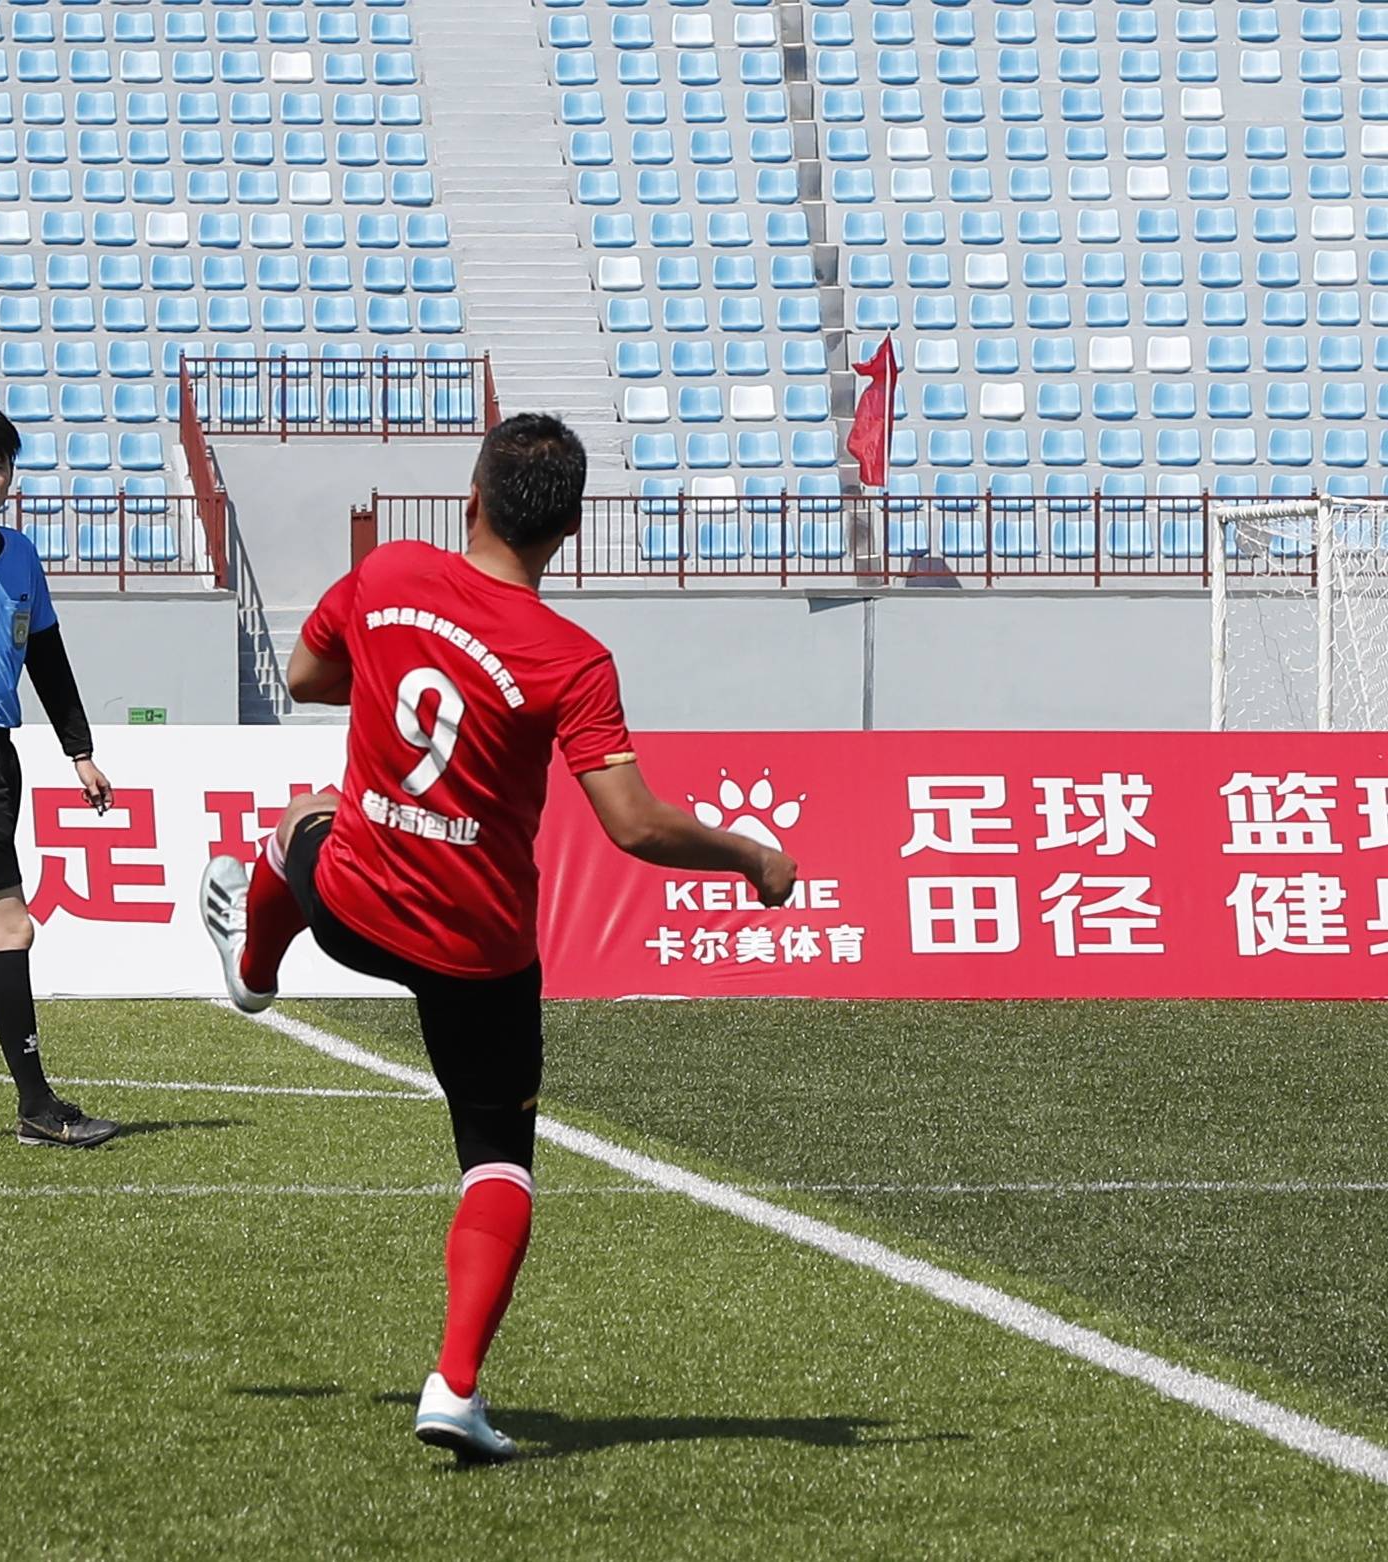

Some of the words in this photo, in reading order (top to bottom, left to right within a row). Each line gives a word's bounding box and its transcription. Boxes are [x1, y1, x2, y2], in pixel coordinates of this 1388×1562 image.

[395, 667, 465, 796] 9
[900, 772, 1156, 857] 足球
[645, 924, 865, 965] 卡尔美体育
[909, 872, 1164, 957] 田径
[1226, 872, 1388, 956] 健
